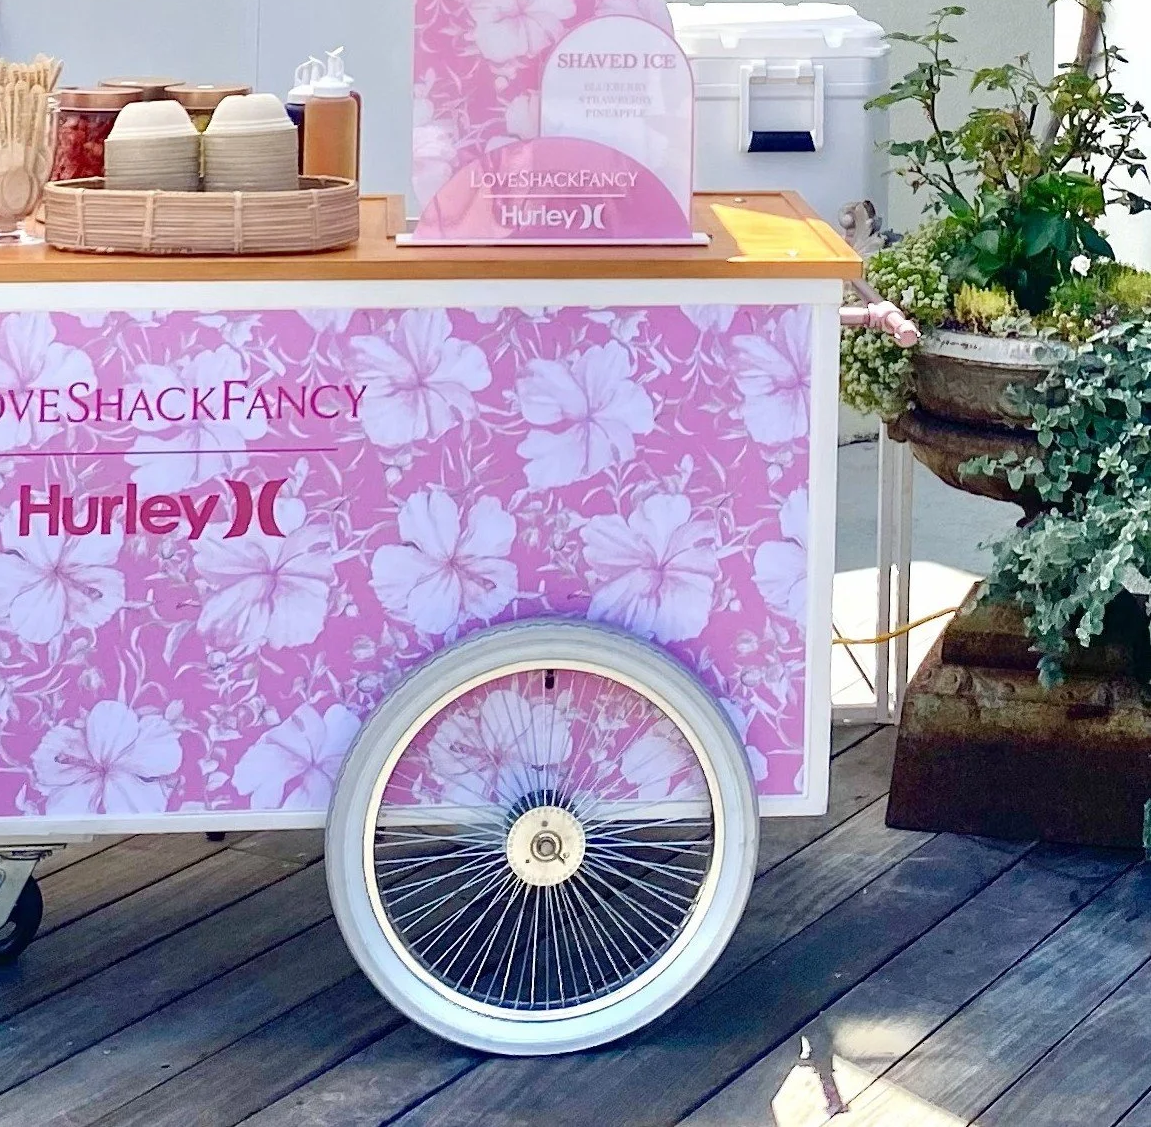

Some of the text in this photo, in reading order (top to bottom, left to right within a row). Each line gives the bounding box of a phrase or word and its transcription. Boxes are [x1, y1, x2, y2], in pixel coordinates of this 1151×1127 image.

[557, 53, 677, 70] SHAVED ICE
[584, 82, 648, 93] BLUEBERRY
[579, 95, 653, 106] STRAWBERRY
[585, 109, 648, 119] PINEAPPLE
[500, 205, 579, 230] Hurley
[18, 482, 221, 541] Hurley
